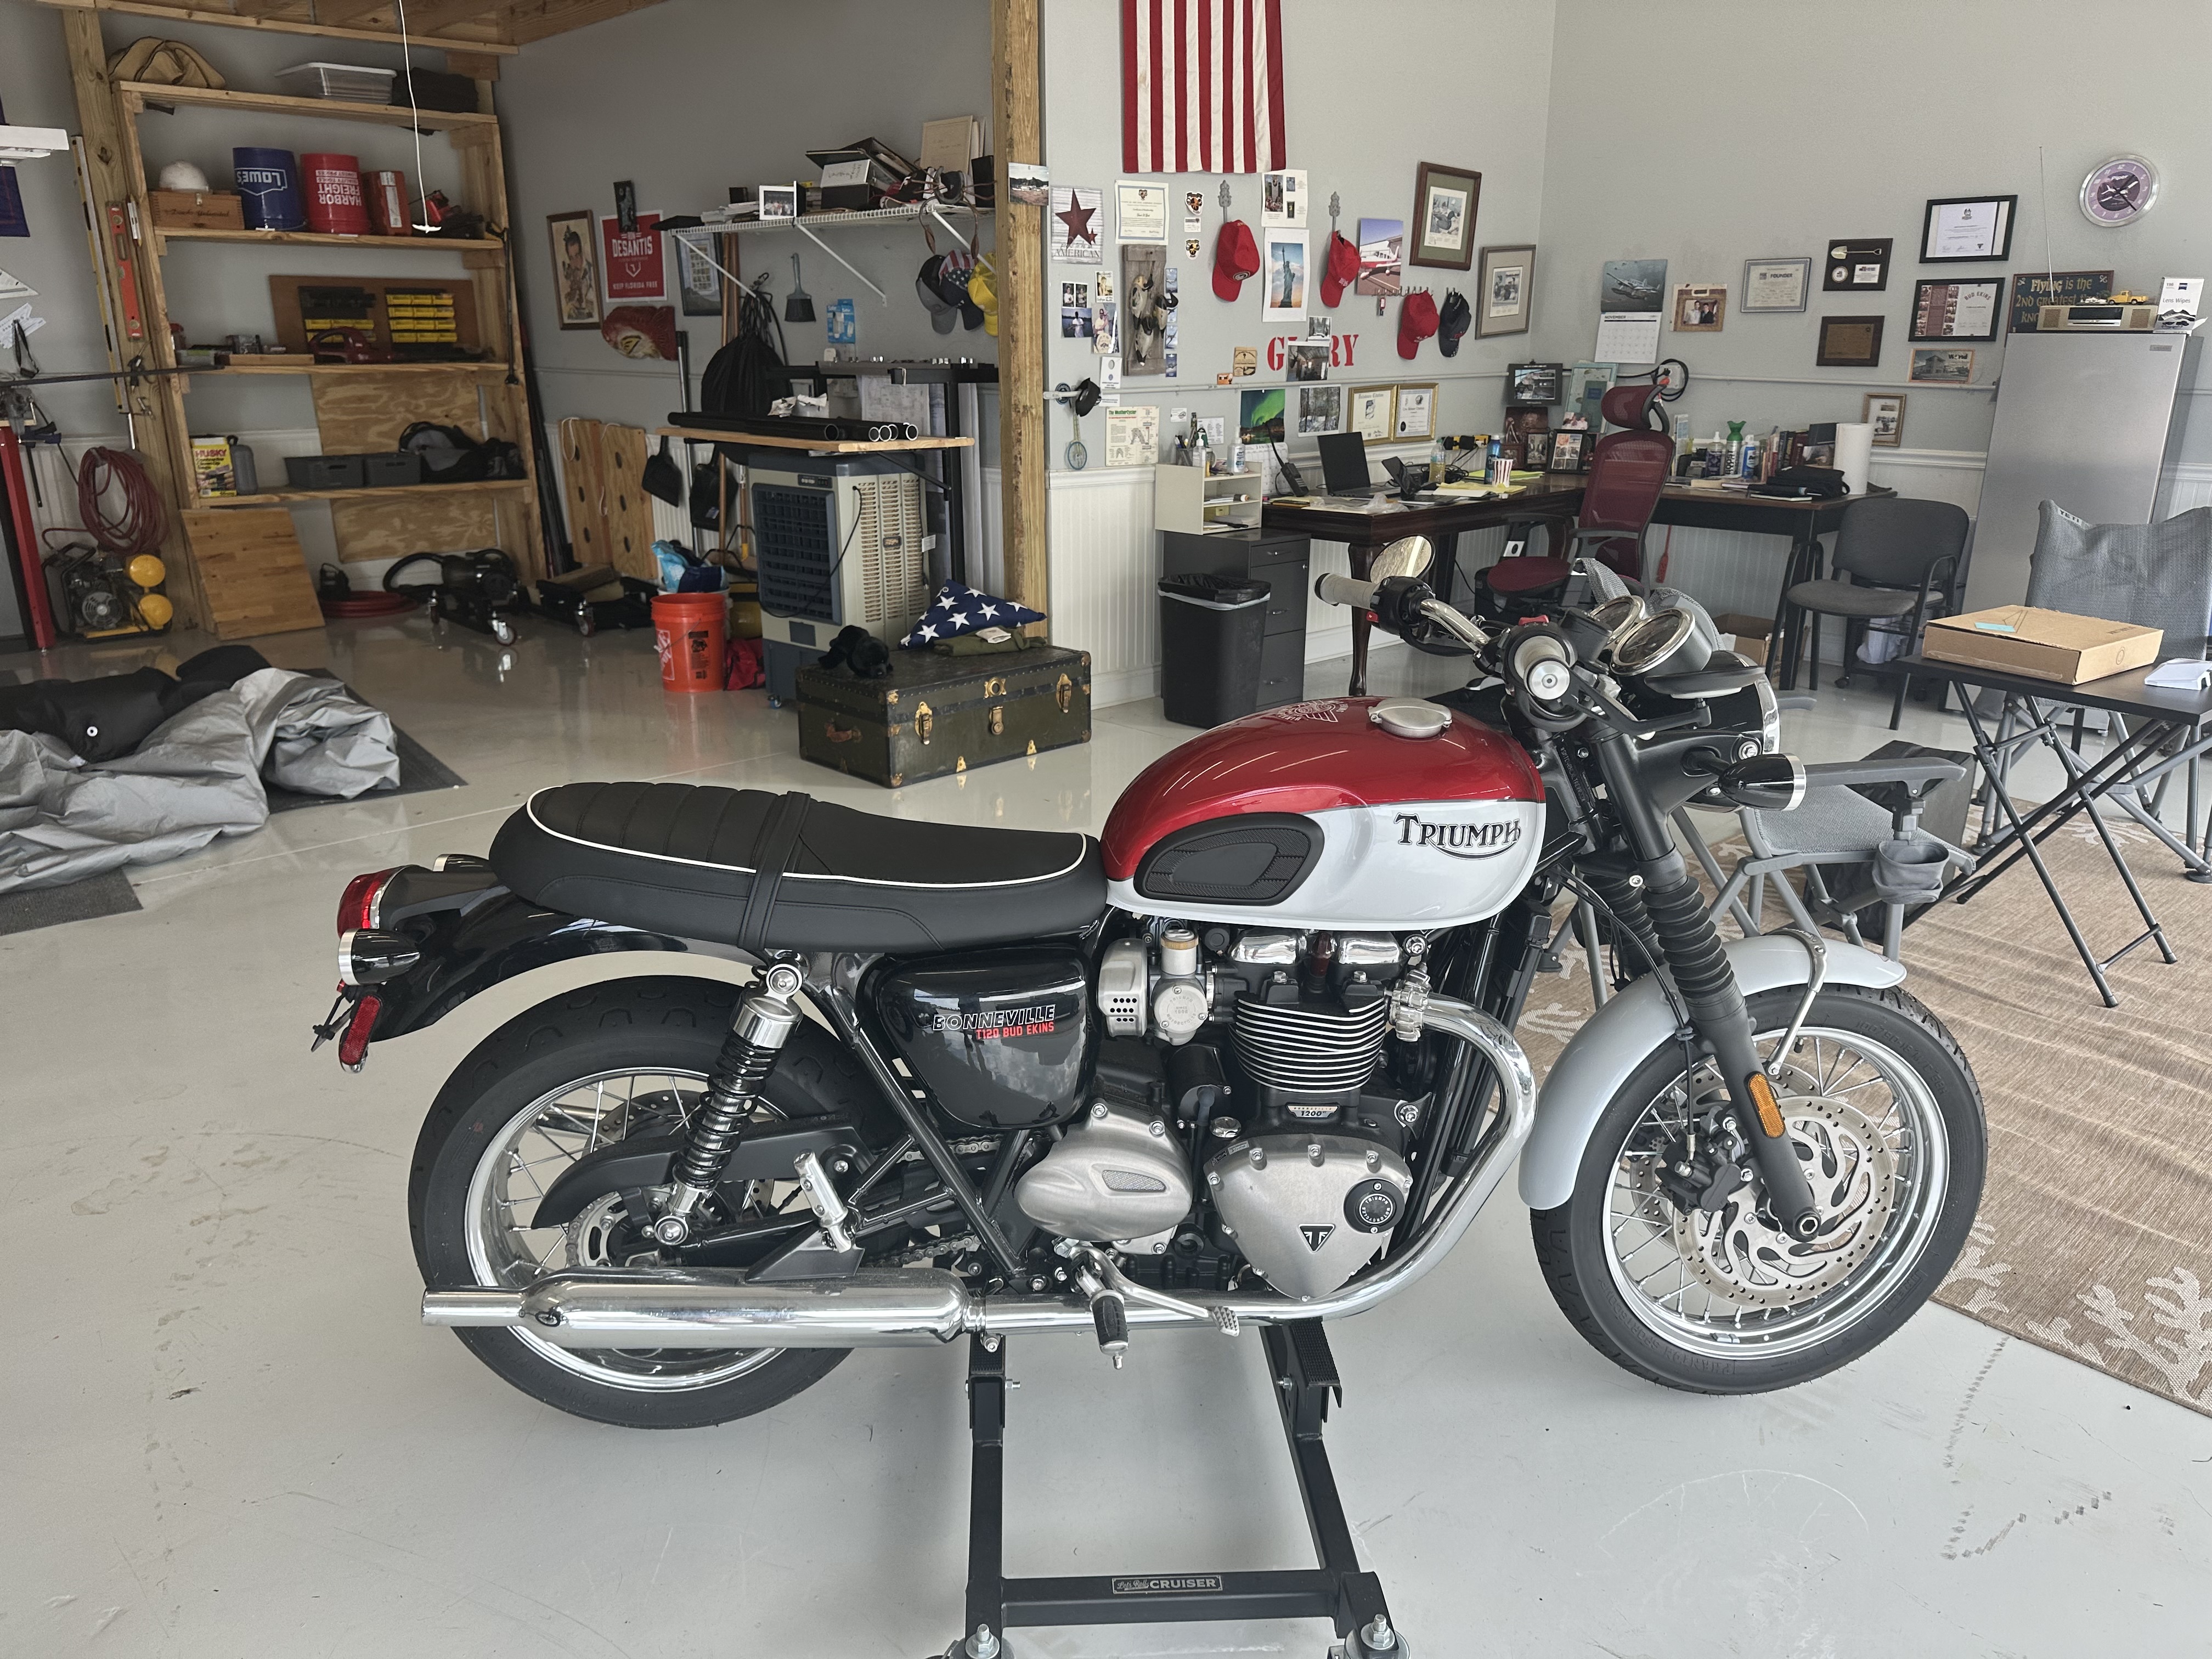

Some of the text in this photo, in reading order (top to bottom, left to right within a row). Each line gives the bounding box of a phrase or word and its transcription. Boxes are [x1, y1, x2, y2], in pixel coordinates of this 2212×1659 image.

[237, 171, 281, 186] LOWE'S
[318, 184, 360, 196] FREIGHT
[319, 194, 362, 206] HARBOR
[612, 236, 653, 257] DESANTIS
[2066, 276, 2073, 290] is
[195, 449, 227, 458] HUSKY
[2060, 510, 2080, 523] YETI
[1393, 812, 1522, 860] TRIUMPH
[932, 1004, 1056, 1031] BONNEVILLE
[975, 1021, 1054, 1040] T120 BUD EKINS
[1365, 1196, 1389, 1205] TRIUMPH
[1150, 1578, 1217, 1589] CRUISER
